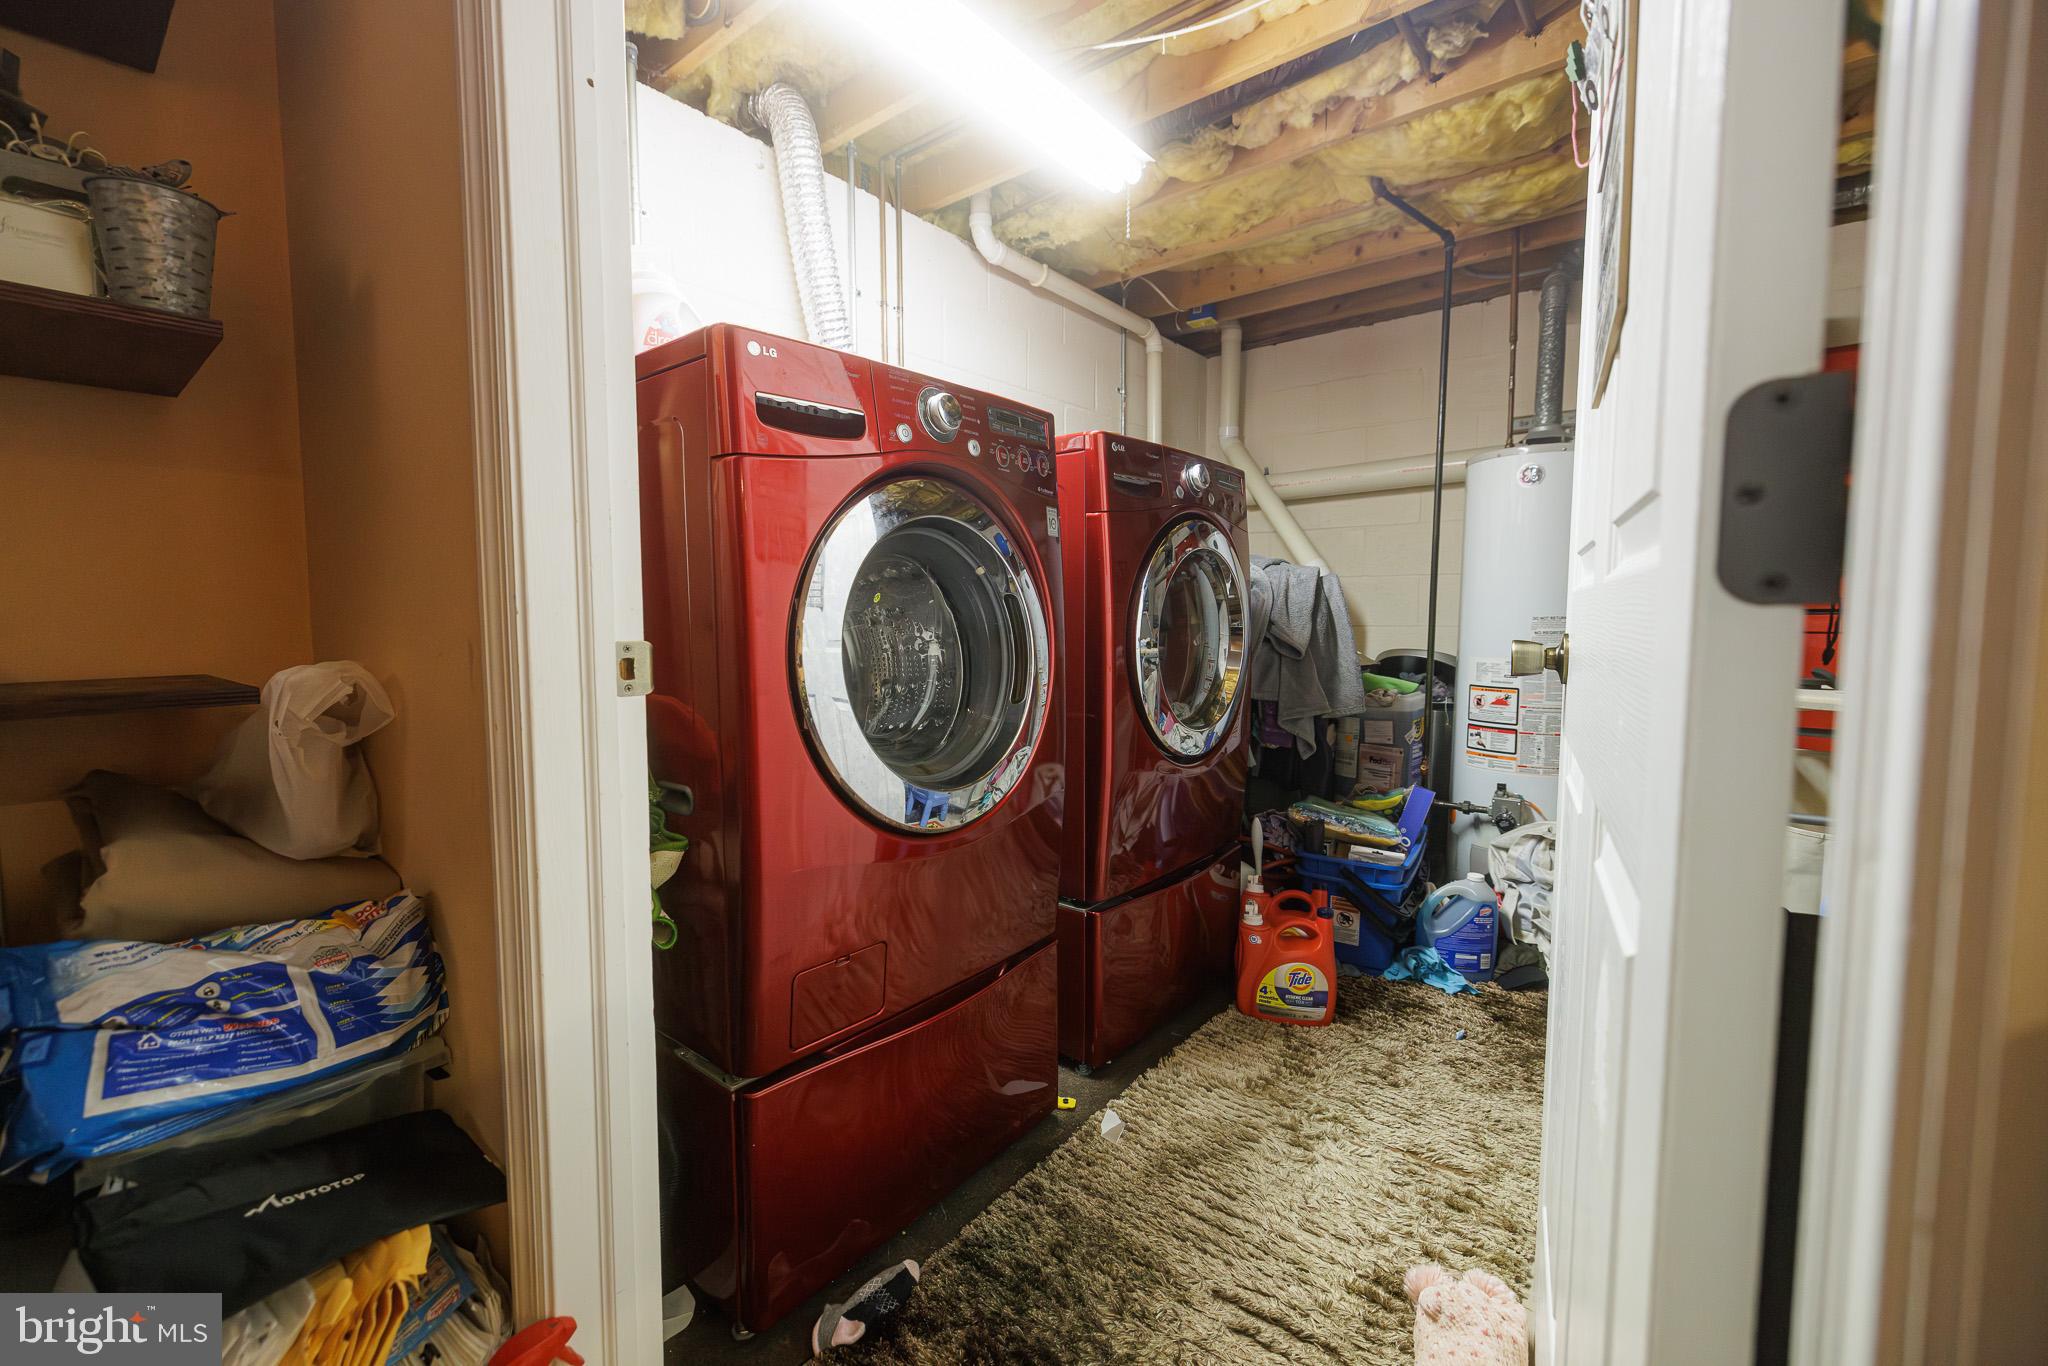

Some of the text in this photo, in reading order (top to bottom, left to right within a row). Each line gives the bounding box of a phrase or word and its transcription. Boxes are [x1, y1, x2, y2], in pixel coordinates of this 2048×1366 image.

[762, 346, 778, 358] LG
[1288, 971, 1313, 988] Tide
[169, 1029, 200, 1038] OTHER
[192, 1034, 214, 1043] HELP
